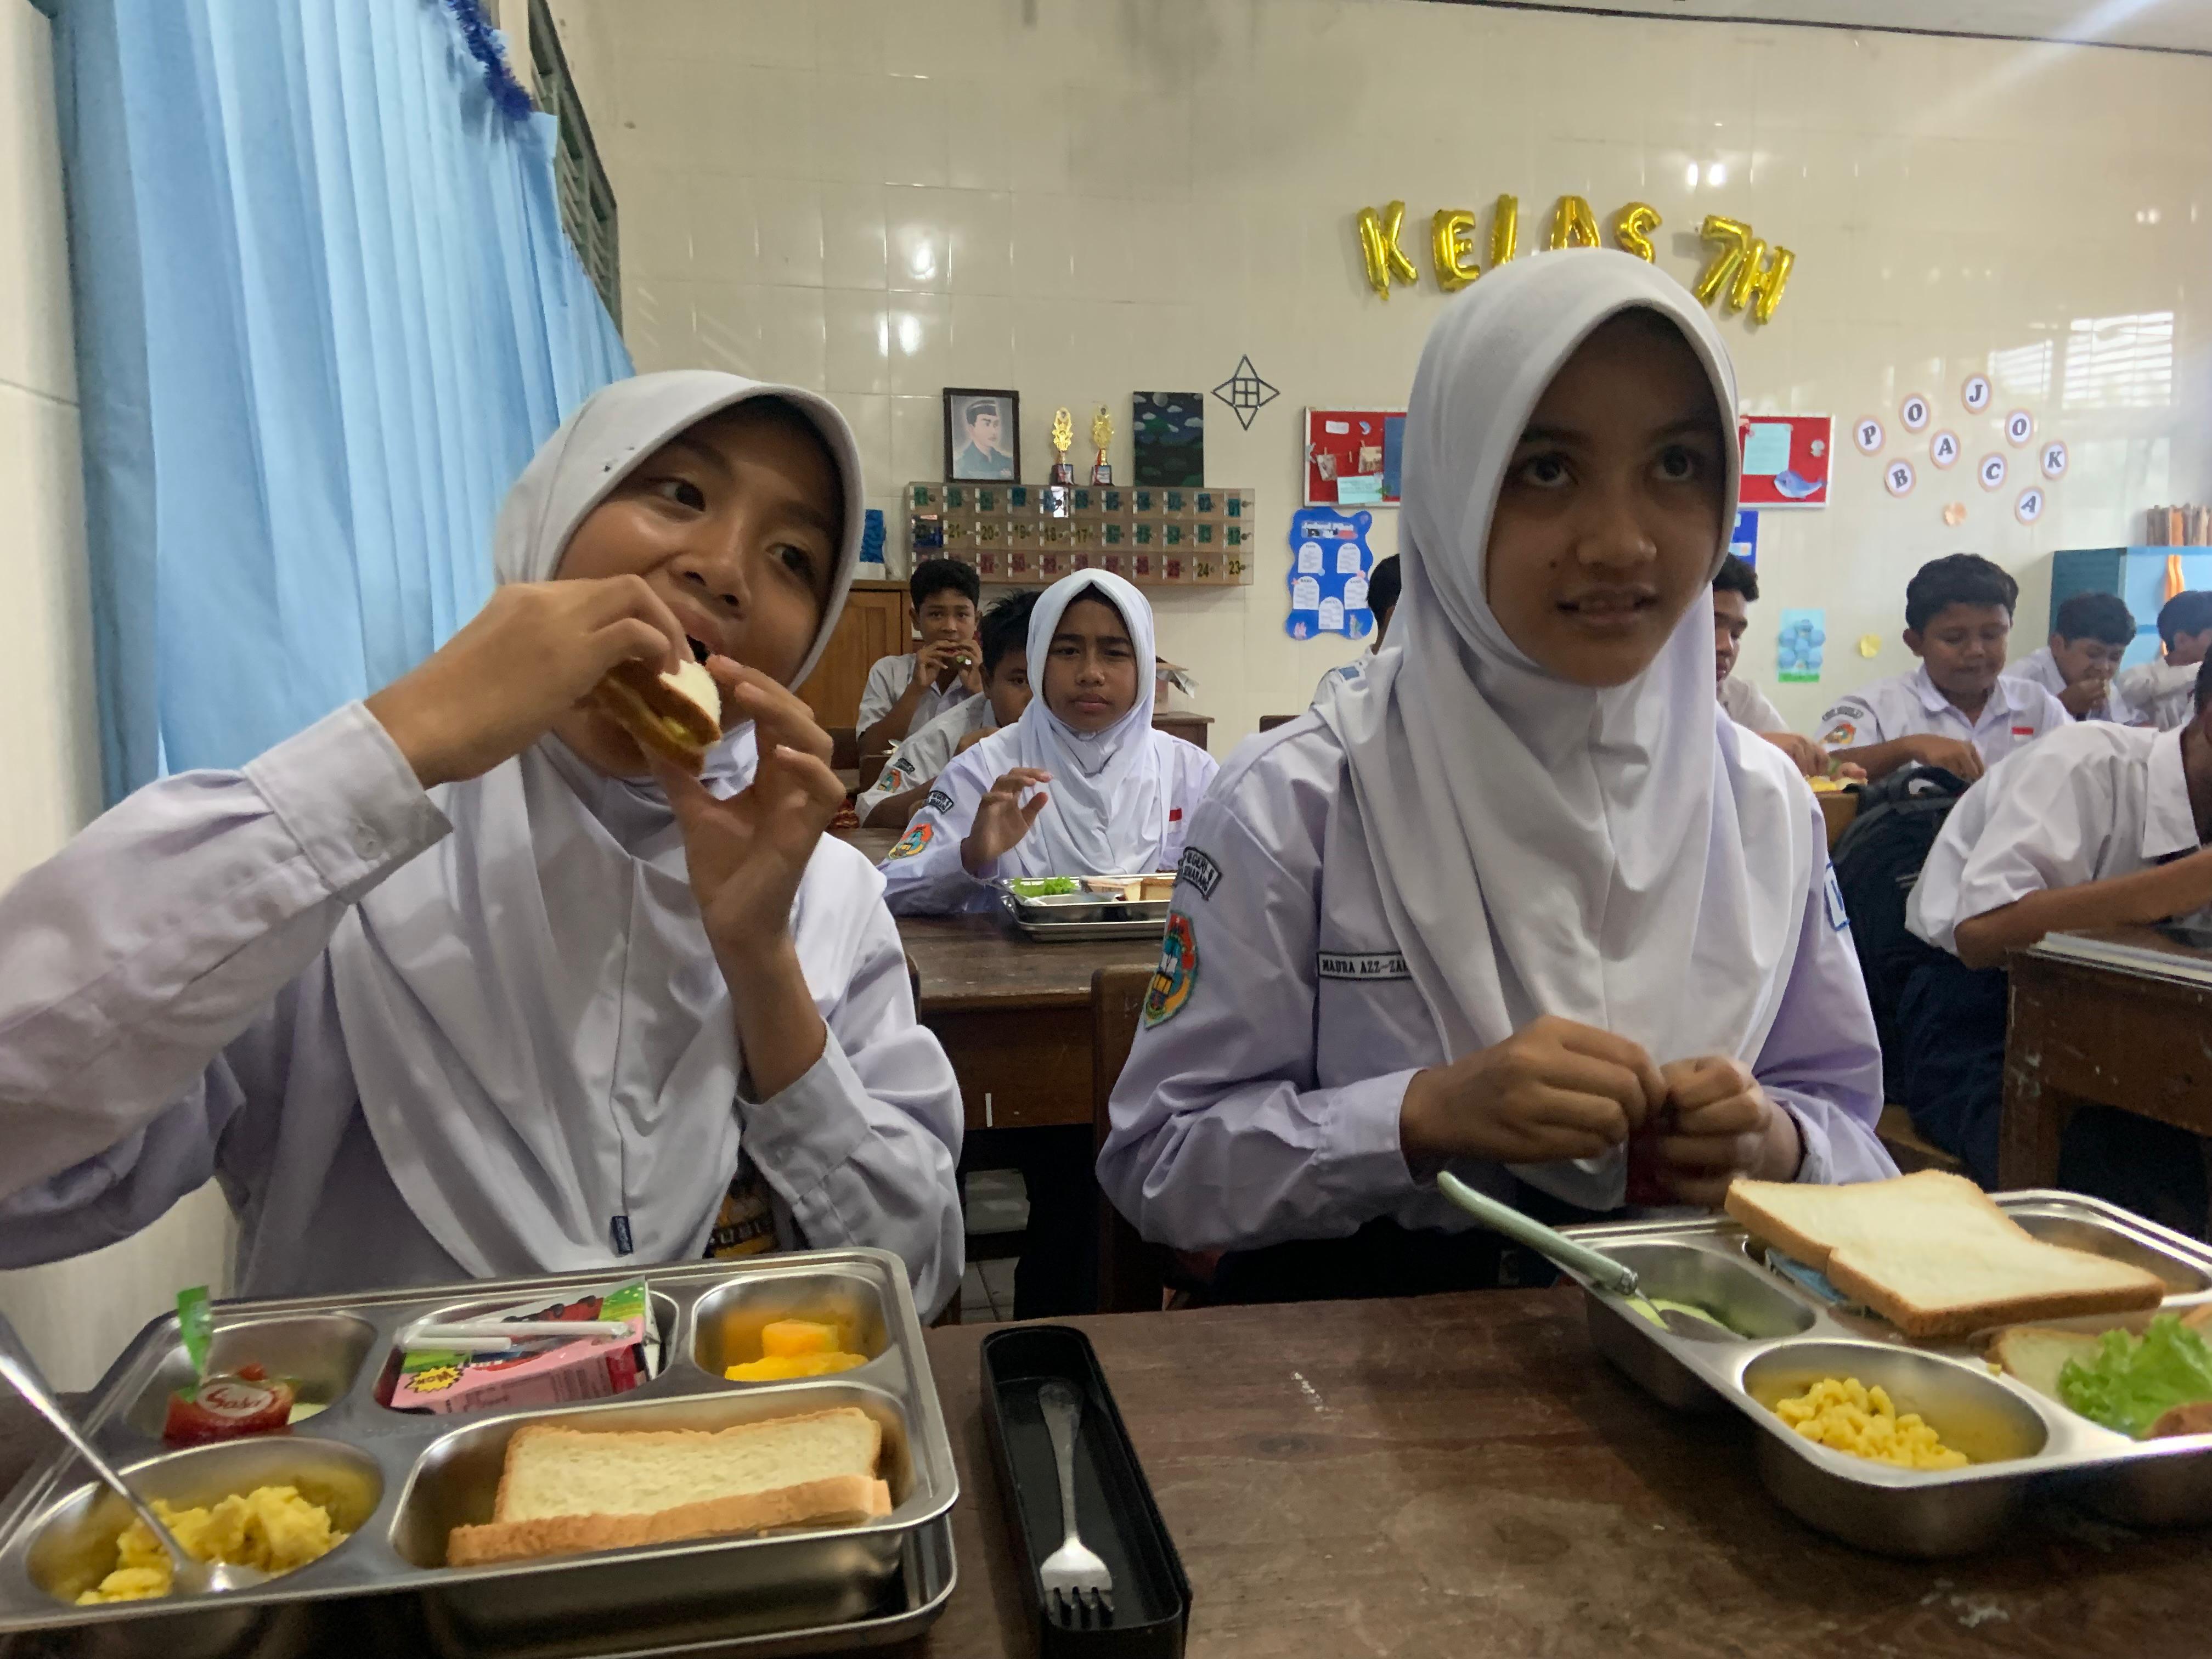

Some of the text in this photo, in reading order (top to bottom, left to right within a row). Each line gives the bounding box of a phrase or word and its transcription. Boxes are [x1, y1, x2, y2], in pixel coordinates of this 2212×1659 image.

[1695, 214, 1797, 325] 7H
[1863, 384, 2063, 469] POJOK
[1892, 437, 2037, 514] BACA
[981, 525, 994, 540] 20
[1077, 528, 1088, 543] 17
[1197, 562, 1209, 577] 24
[1228, 560, 1241, 575] 23
